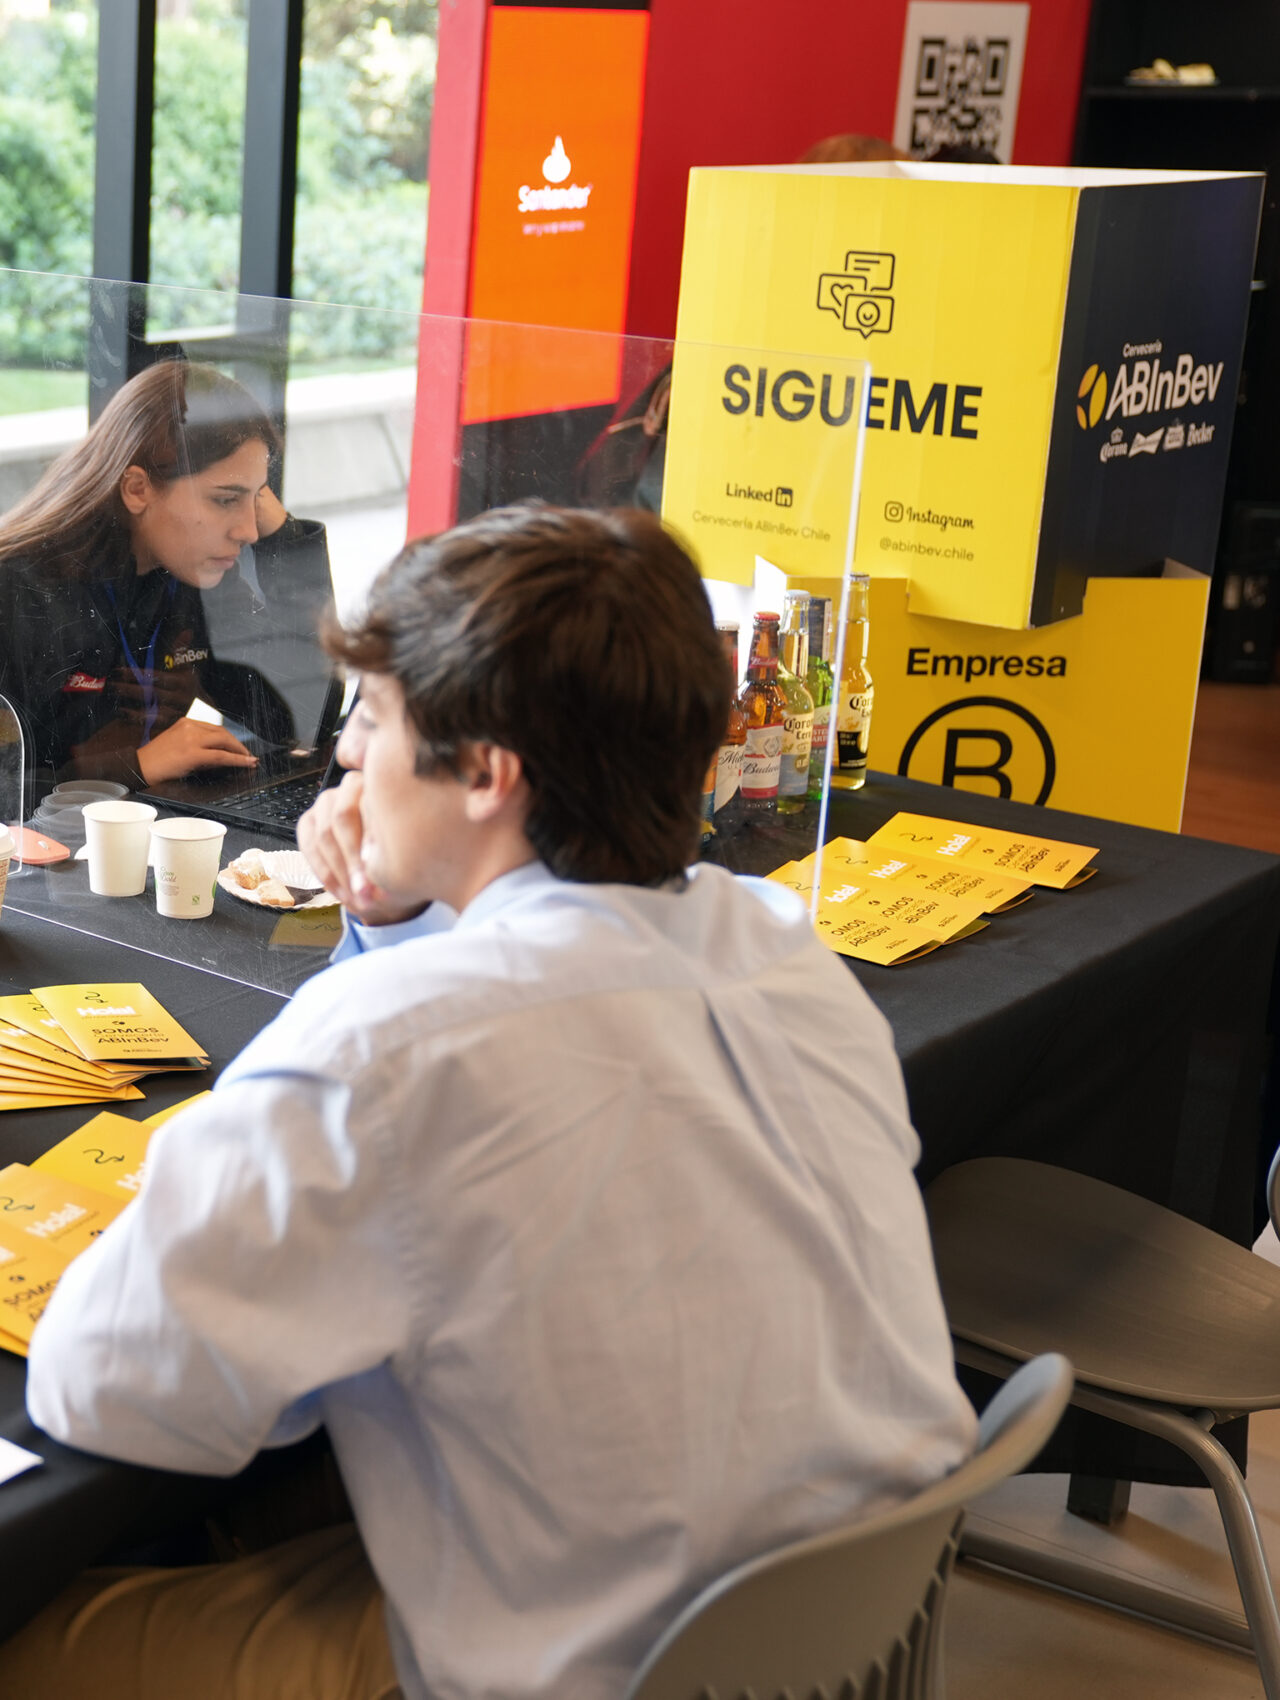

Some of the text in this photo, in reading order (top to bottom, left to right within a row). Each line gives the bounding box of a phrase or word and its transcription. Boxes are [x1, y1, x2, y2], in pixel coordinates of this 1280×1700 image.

[1105, 353, 1224, 421] ABInBev
[722, 364, 983, 440] SIGUEME
[906, 506, 975, 532] Instagram
[801, 526, 831, 542] Chile
[879, 537, 975, 562] @abinbev.chile
[906, 647, 1067, 683] Empresa
[881, 896, 915, 917] OMOS
[831, 918, 867, 936] OMOS
[97, 1036, 169, 1044] ABInBev
